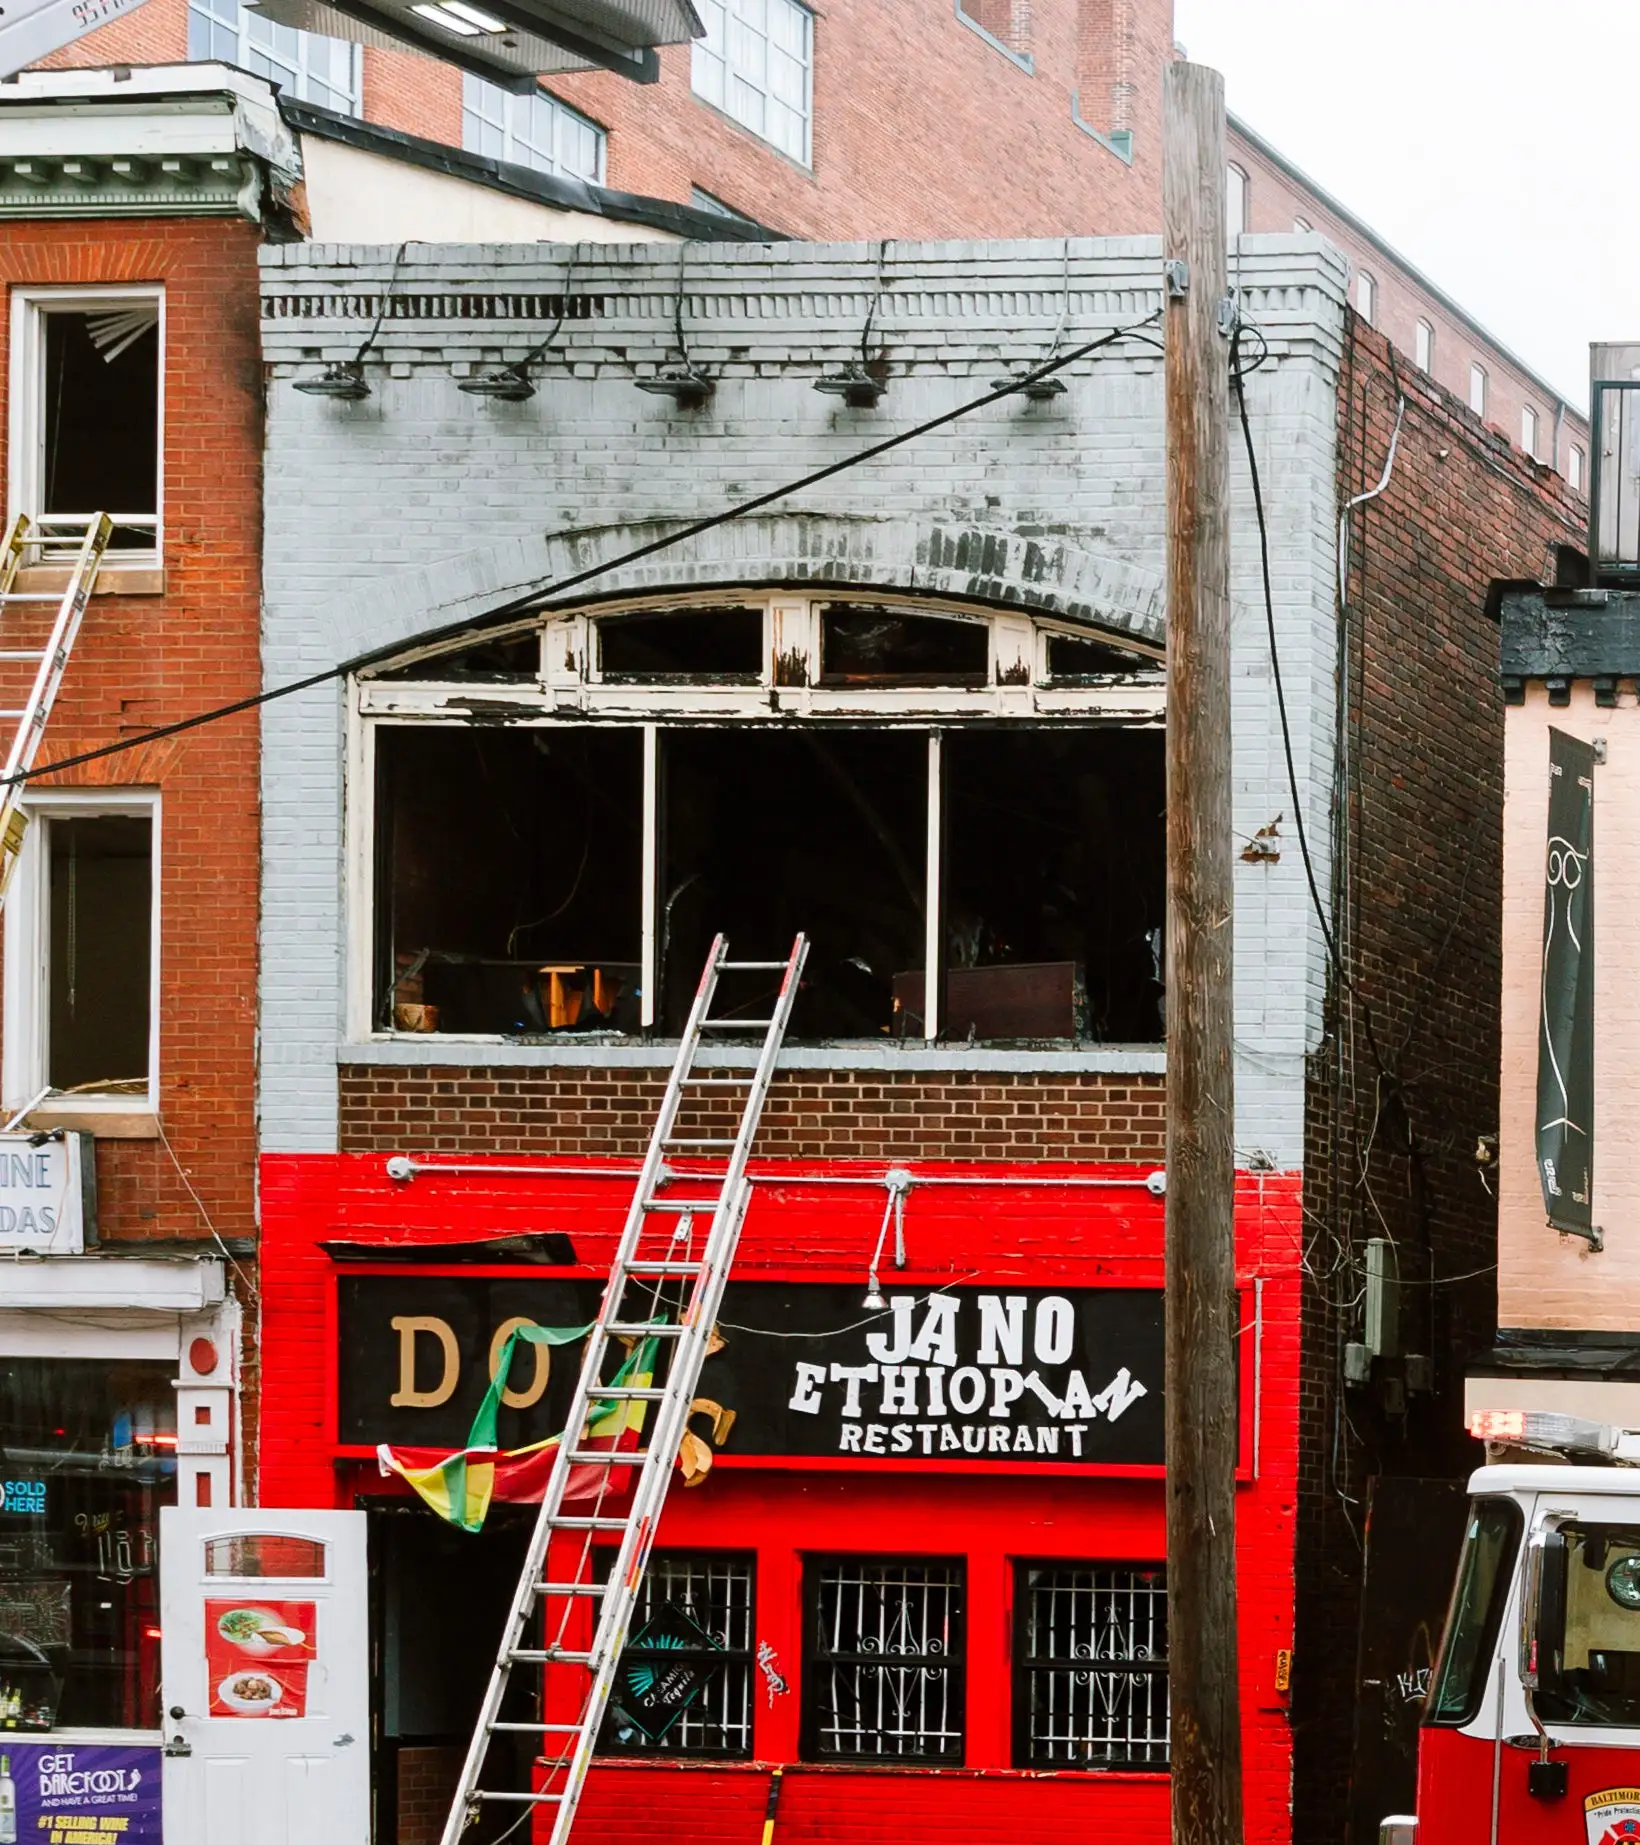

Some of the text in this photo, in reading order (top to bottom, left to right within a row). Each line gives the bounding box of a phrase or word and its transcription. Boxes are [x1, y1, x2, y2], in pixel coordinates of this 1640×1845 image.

[788, 1362, 1148, 1422] ETHIOPIAN
[839, 1424, 1089, 1457] RESTAURANT
[4, 1481, 46, 1496] SOLD
[4, 1497, 46, 1513] HERE
[38, 1754, 75, 1773] GET
[40, 1769, 126, 1797] BAREFOOT
[41, 1798, 60, 1807] AND
[61, 1797, 82, 1805] HAVE
[83, 1796, 91, 1805] A
[92, 1795, 116, 1804] GREAT
[37, 1816, 130, 1831] #1 SELLING WINE
[51, 1831, 118, 1845] IN AMERICA!
